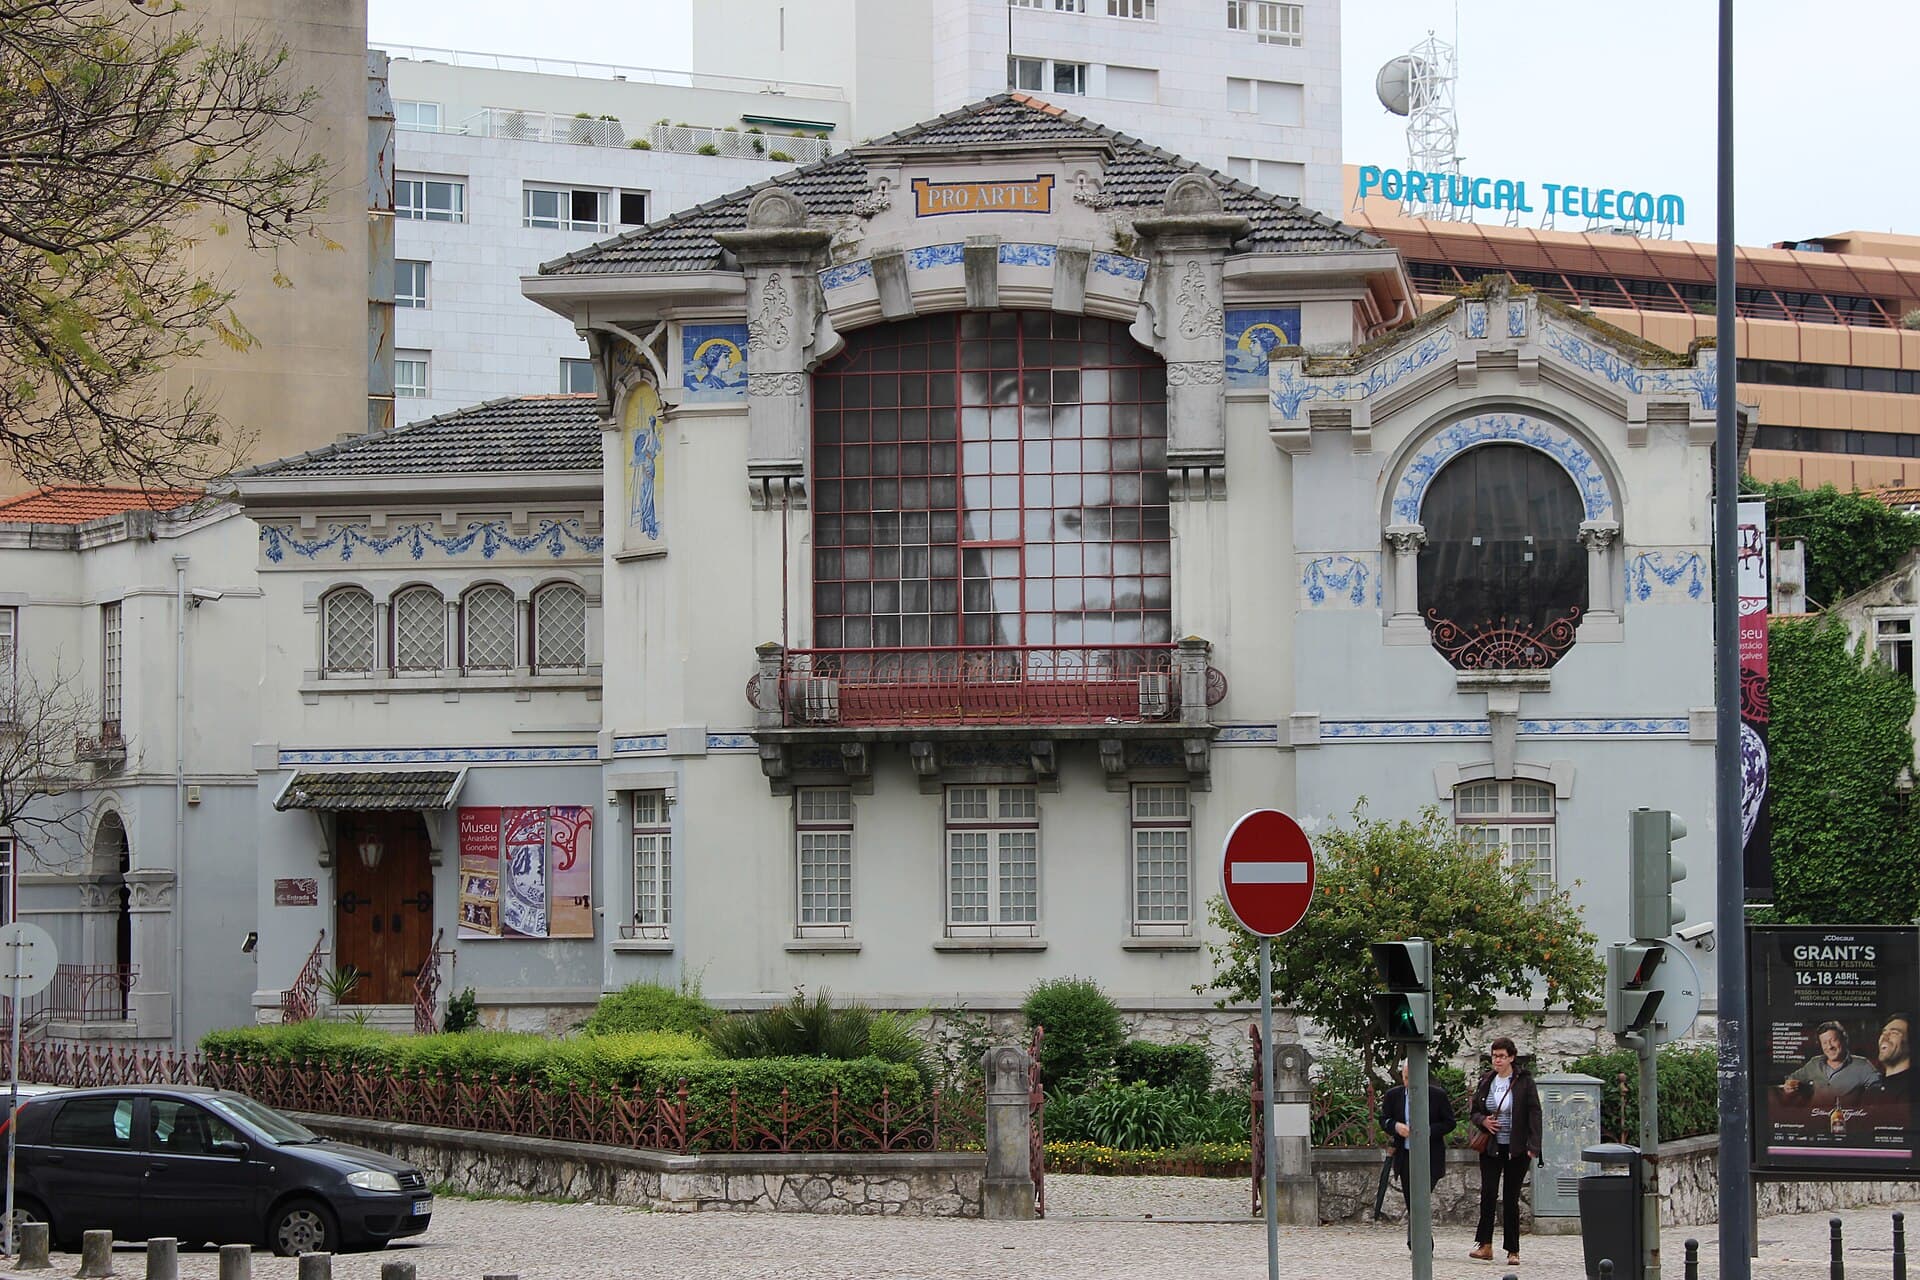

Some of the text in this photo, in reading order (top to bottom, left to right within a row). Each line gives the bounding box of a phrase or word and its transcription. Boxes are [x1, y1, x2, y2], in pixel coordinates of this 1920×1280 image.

[928, 186, 1038, 208] PRO ARTE
[1359, 166, 1685, 226] PORTUGAL TELECOM
[1740, 629, 1763, 640] seu
[461, 822, 498, 833] Museu
[467, 834, 498, 842] Anastácio
[465, 843, 497, 852] Gonçalves
[1793, 945, 1876, 960] GRANT'S
[1795, 971, 1859, 985] 16-18 ABRIL
